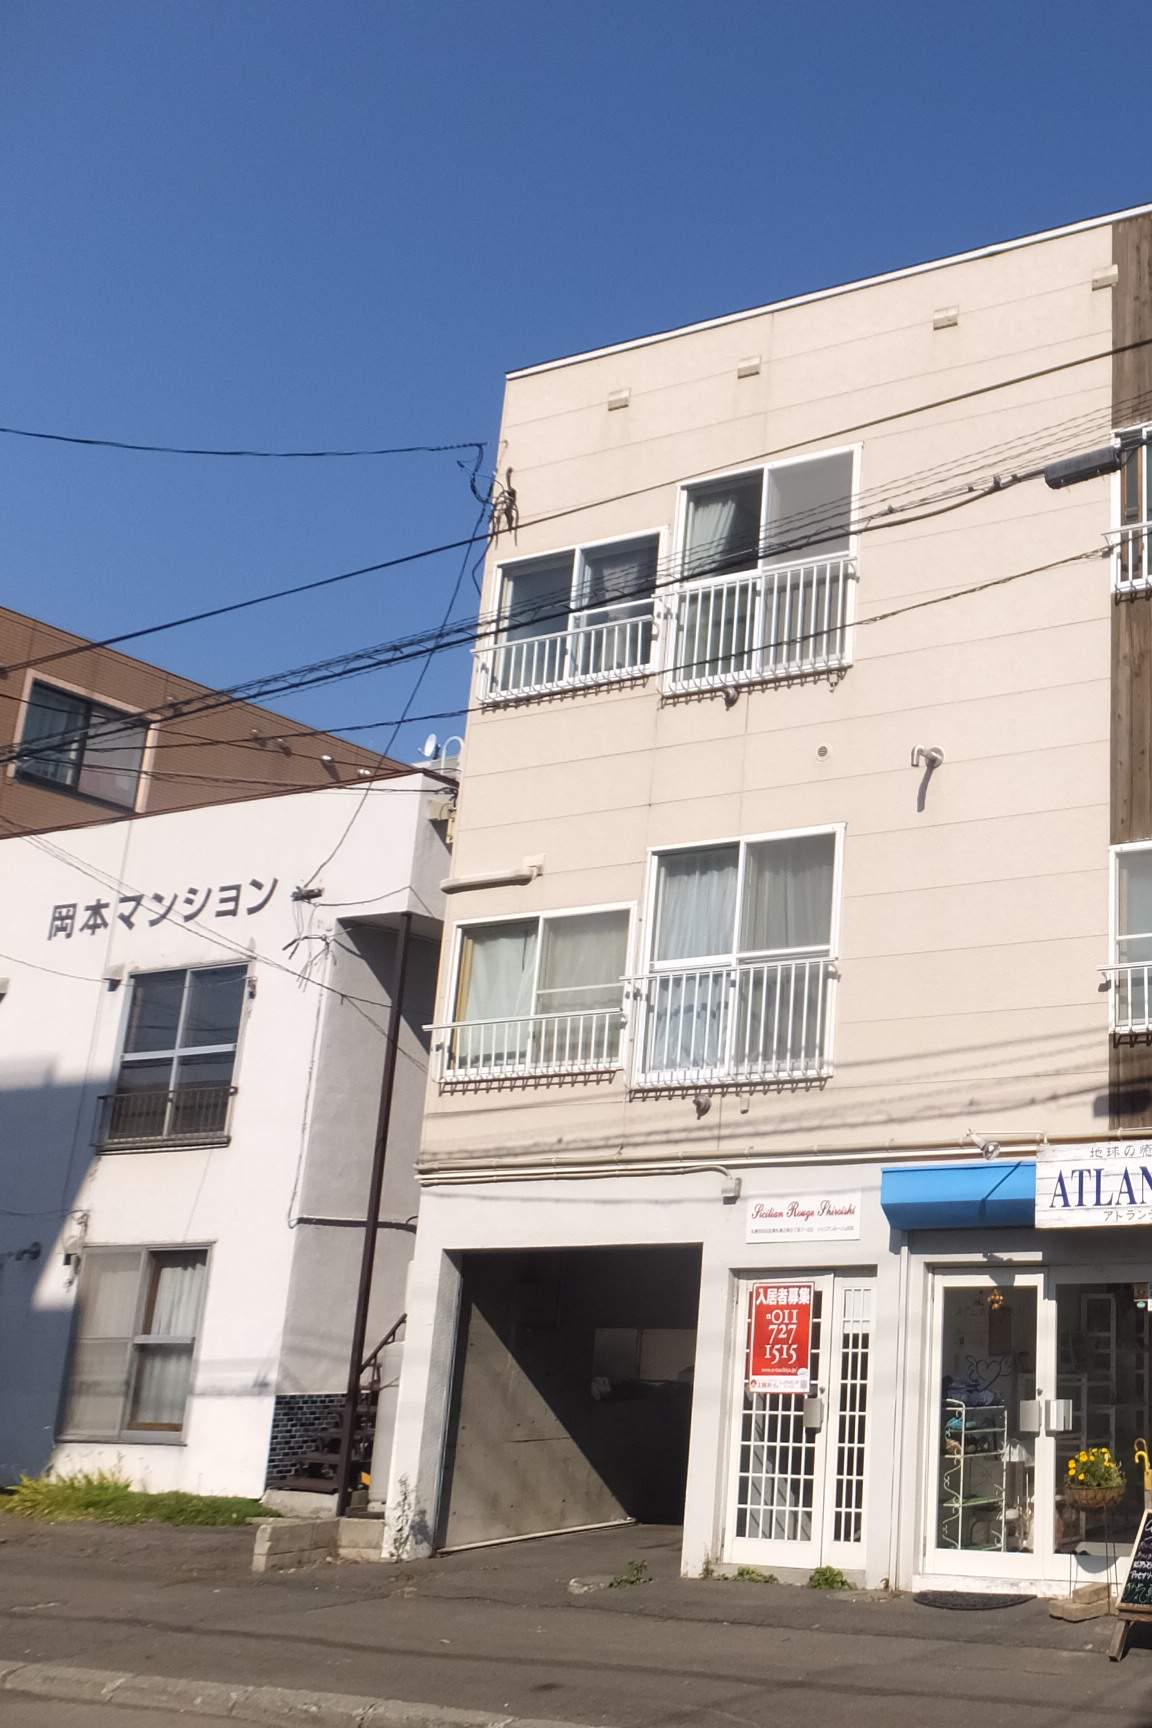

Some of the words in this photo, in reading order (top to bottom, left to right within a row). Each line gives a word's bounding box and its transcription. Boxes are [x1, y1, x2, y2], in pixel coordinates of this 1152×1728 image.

[751, 1203, 784, 1219] Sicilian
[786, 1200, 815, 1222] Rouge
[817, 1200, 856, 1216] Shiroishi
[756, 1287, 810, 1305] 入居者募集
[772, 1309, 799, 1323] 011
[768, 1324, 797, 1344] 727
[764, 1344, 798, 1365] 1515
